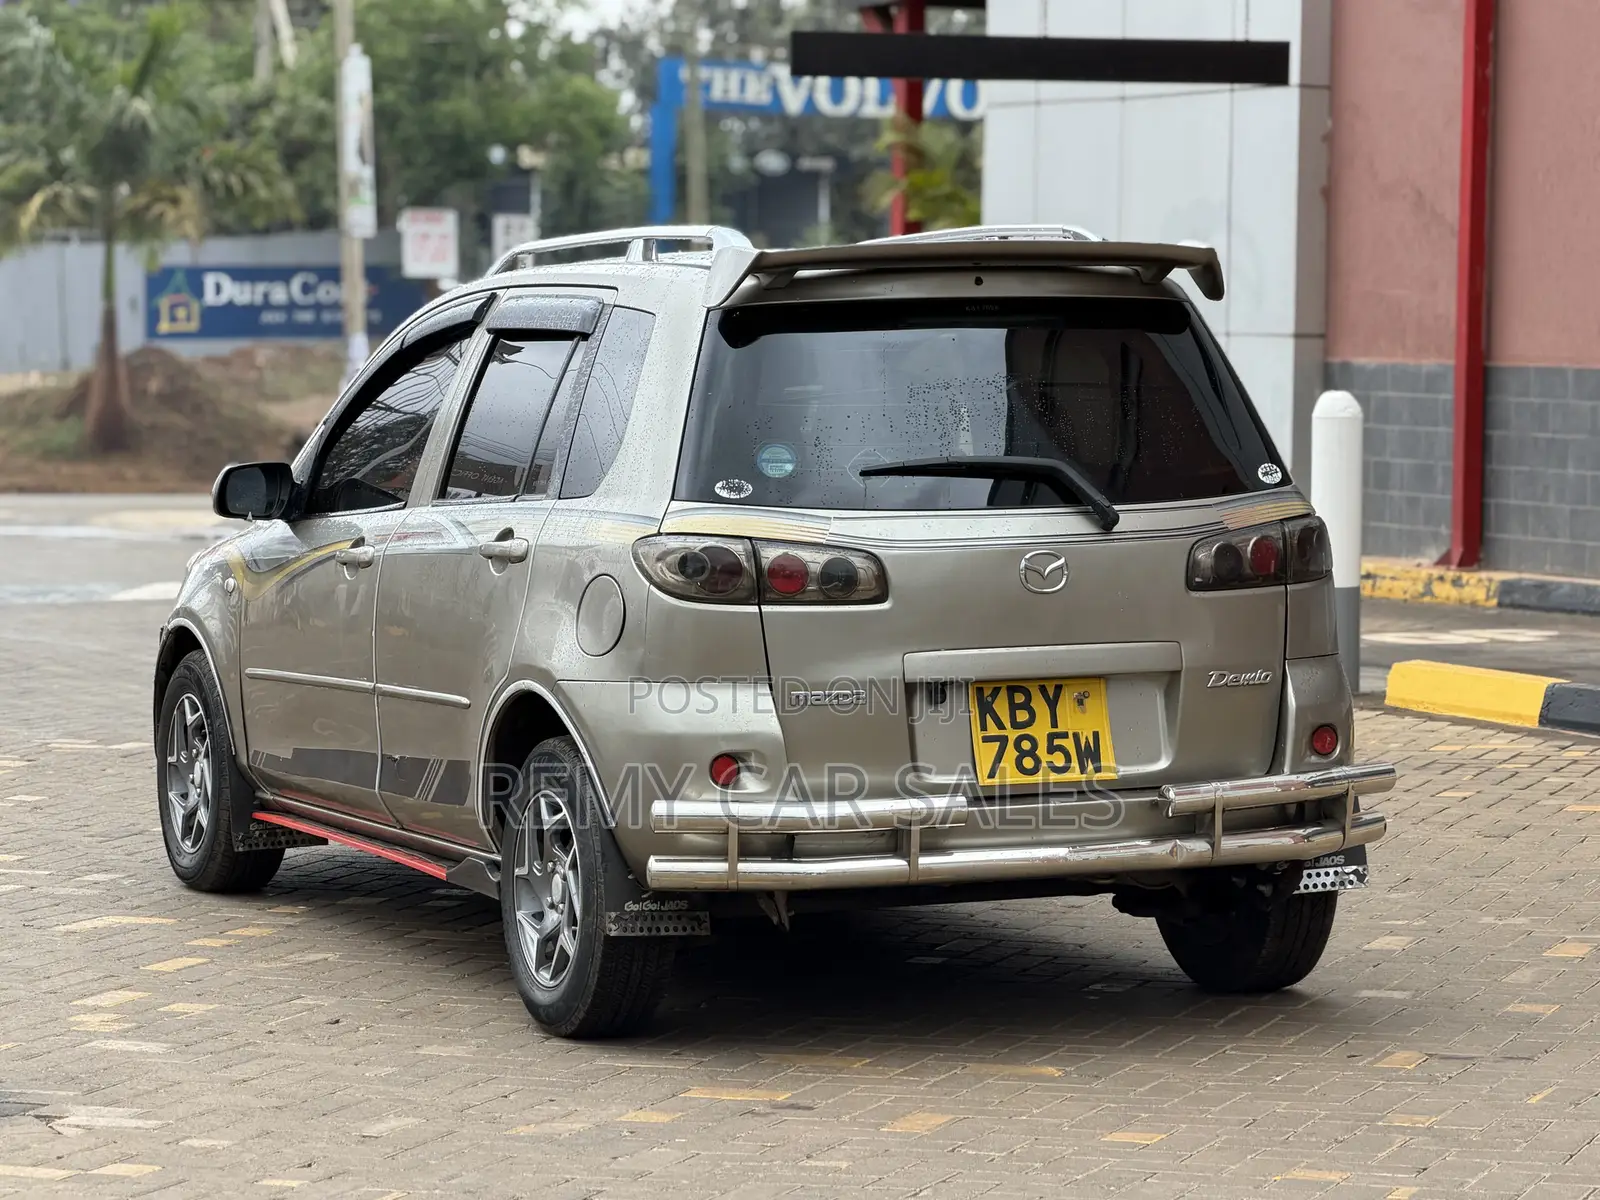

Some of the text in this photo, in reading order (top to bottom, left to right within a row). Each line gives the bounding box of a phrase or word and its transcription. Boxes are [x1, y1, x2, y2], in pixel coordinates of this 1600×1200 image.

[203, 271, 369, 307] DuraCo
[1206, 669, 1273, 688] Demio
[976, 683, 1064, 732] KBY
[981, 730, 1103, 780] 785W
